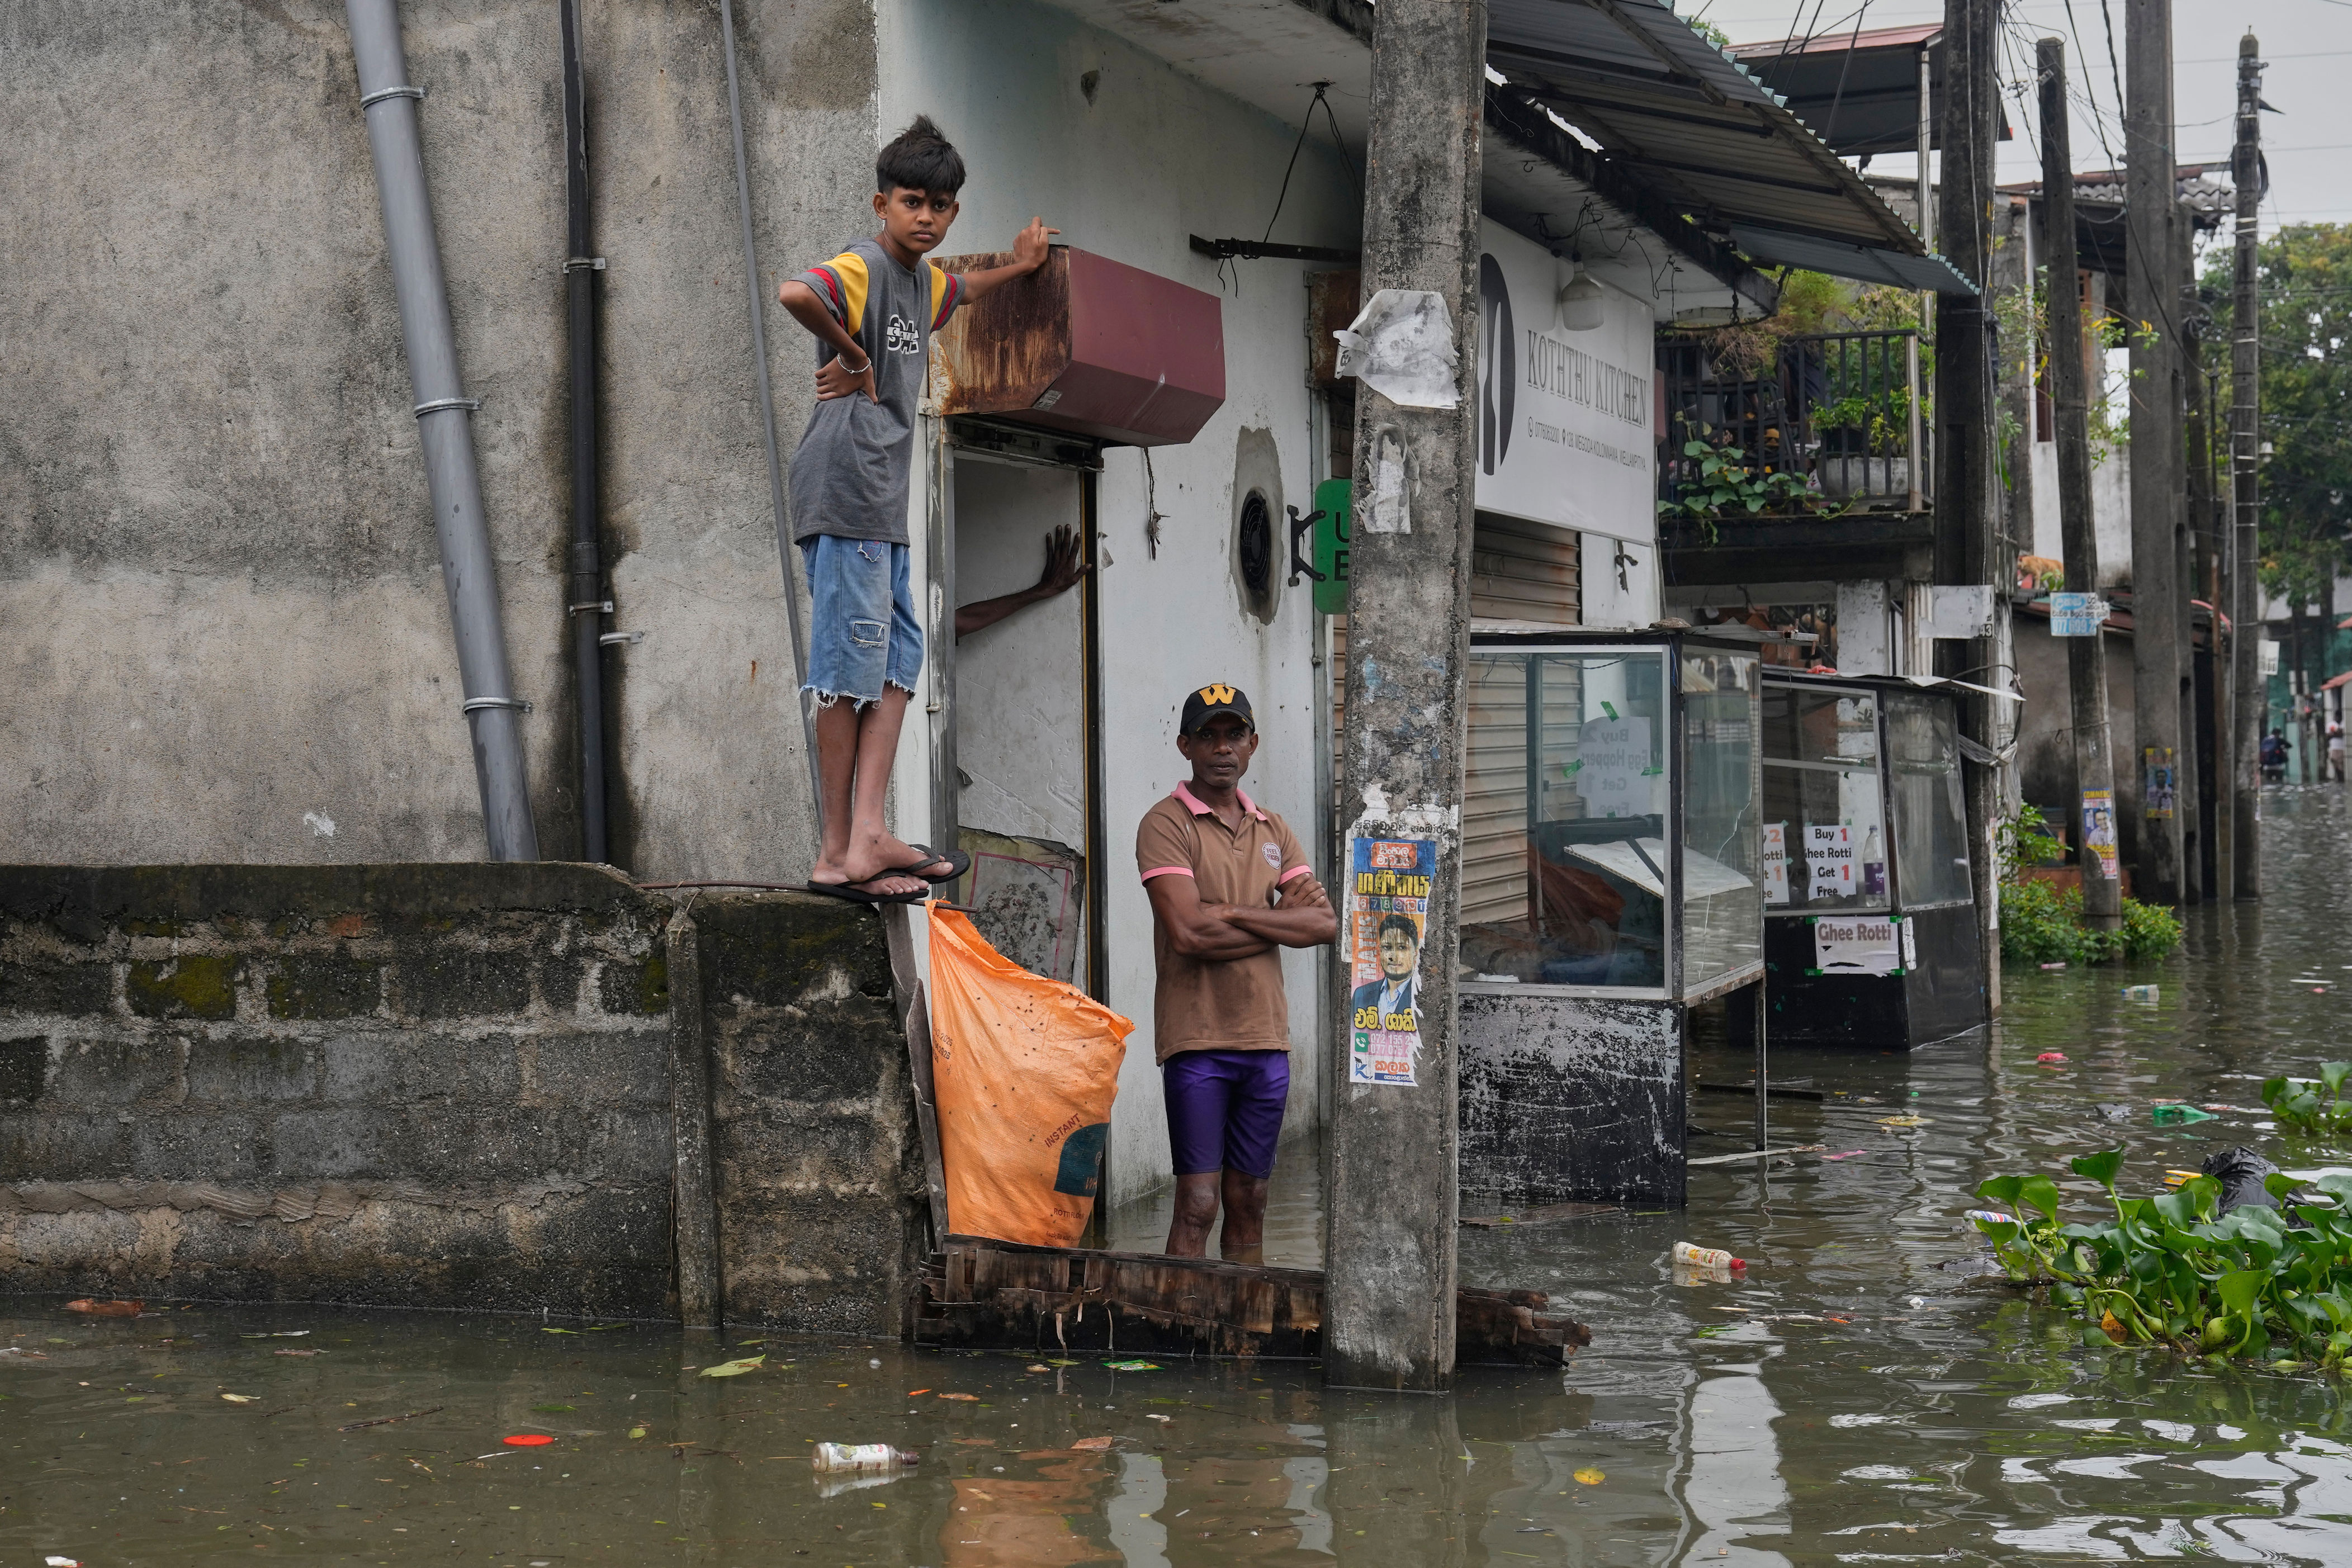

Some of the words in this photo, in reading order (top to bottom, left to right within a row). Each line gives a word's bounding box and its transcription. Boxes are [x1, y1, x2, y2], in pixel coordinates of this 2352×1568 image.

[1528, 329, 1592, 409] KOTHTHU
[1596, 358, 1646, 429] KITCHEN
[1575, 434, 1593, 454] MEGODA
[1199, 683, 1236, 705] W
[1769, 829, 1781, 842] 2
[1815, 828, 1834, 841] Buy
[1840, 828, 1847, 841] 1
[1764, 850, 1783, 861] otti
[1828, 847, 1852, 858] Rotti
[1774, 865, 1782, 881] 1
[1818, 866, 1835, 878] Get
[1842, 865, 1849, 880] 1
[1817, 886, 1838, 897] Free
[1383, 898, 1390, 908] 8
[1395, 899, 1403, 909] 9
[1818, 923, 1853, 941] Ghee
[1857, 923, 1891, 941] Rotti
[1371, 1033, 1385, 1044] 072
[1370, 1044, 1385, 1054] 077
[1044, 1113, 1080, 1148] INSTANT
[1054, 1208, 1071, 1218] ROTTI
